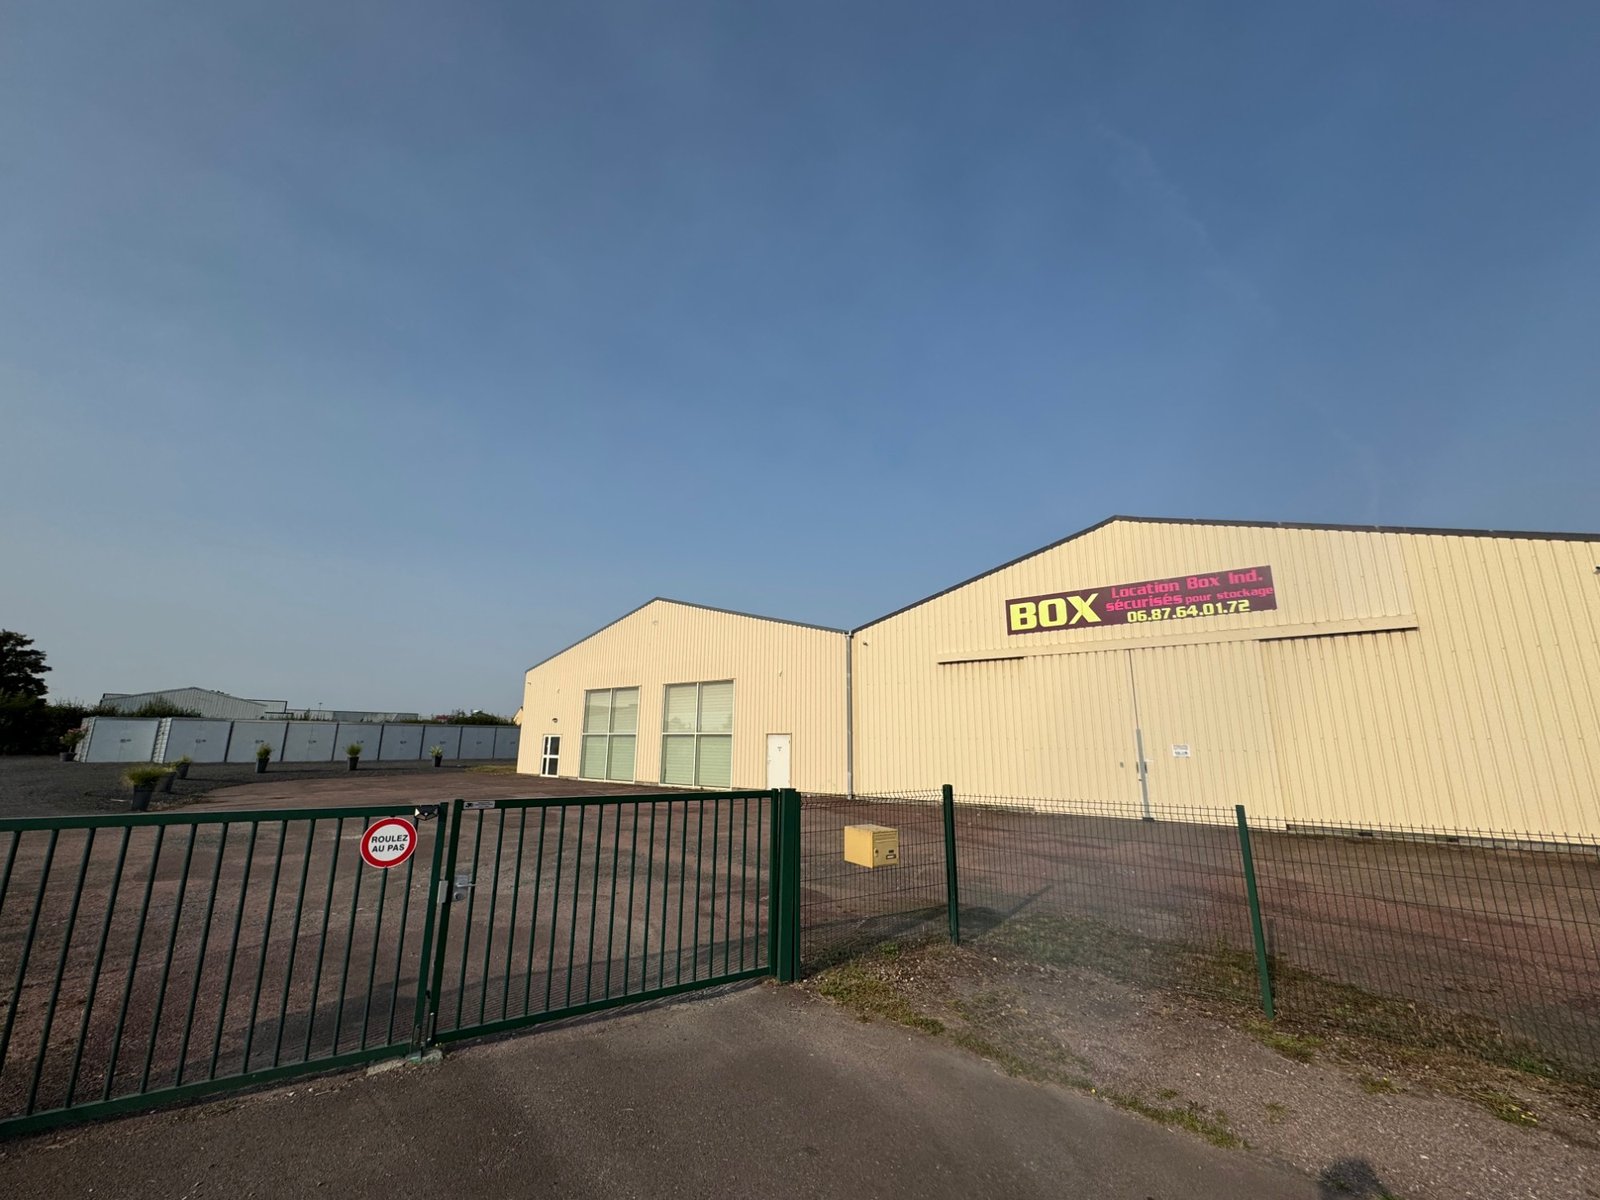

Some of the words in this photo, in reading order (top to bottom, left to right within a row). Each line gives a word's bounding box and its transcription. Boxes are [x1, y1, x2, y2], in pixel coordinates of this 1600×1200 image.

[1111, 581, 1180, 599] Location
[1186, 576, 1220, 590] Box
[1227, 569, 1263, 585] Ind.
[1009, 592, 1102, 631] BOX
[1105, 593, 1183, 612] sécurisés
[1185, 593, 1212, 605] pour
[1216, 586, 1273, 601] stockage
[1126, 599, 1251, 623] 06.87.64.01.72
[371, 834, 409, 844] ROULEZ
[371, 845, 385, 853] AU
[387, 843, 405, 852] PAS
